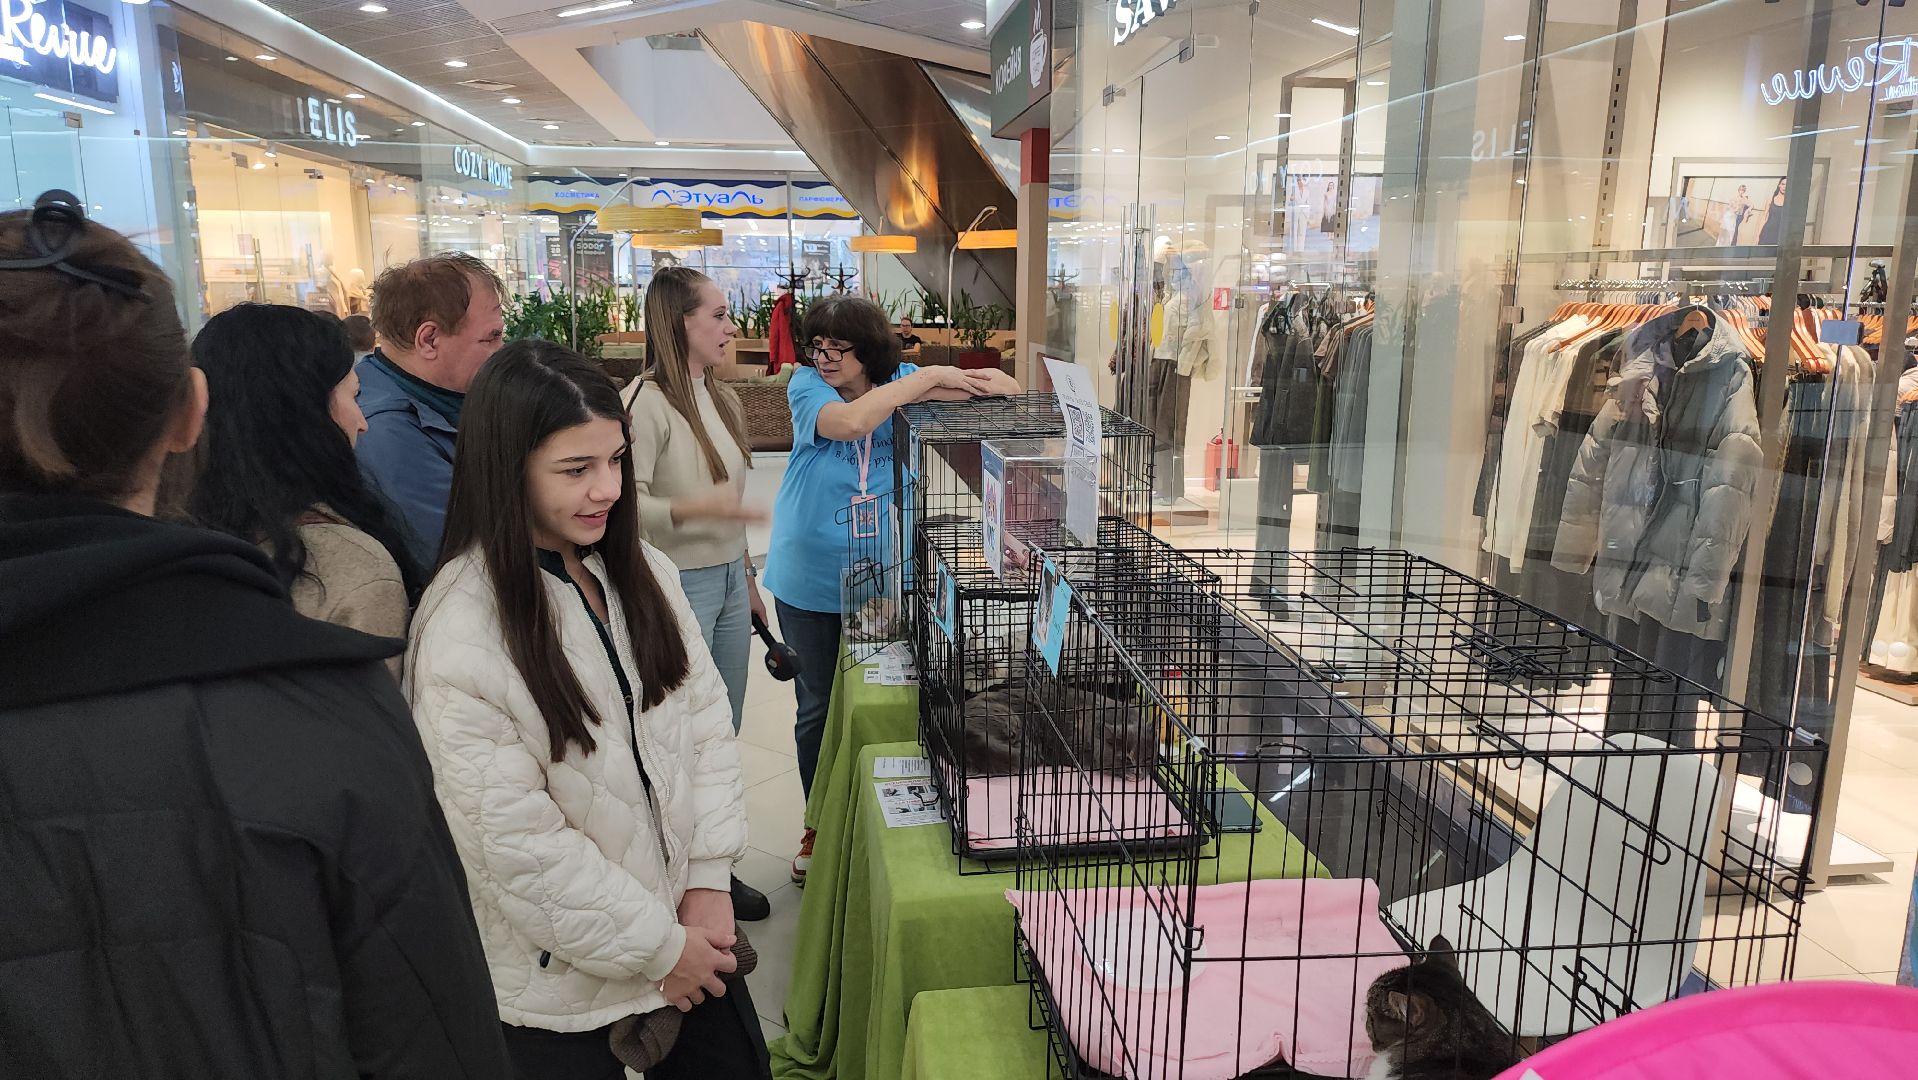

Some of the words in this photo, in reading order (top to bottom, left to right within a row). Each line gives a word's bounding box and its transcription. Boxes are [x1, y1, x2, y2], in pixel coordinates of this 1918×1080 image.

[307, 96, 357, 147] ELIS
[454, 146, 483, 180] COZY
[487, 159, 513, 190] HOME
[554, 191, 600, 199] КОСМЕТИКА
